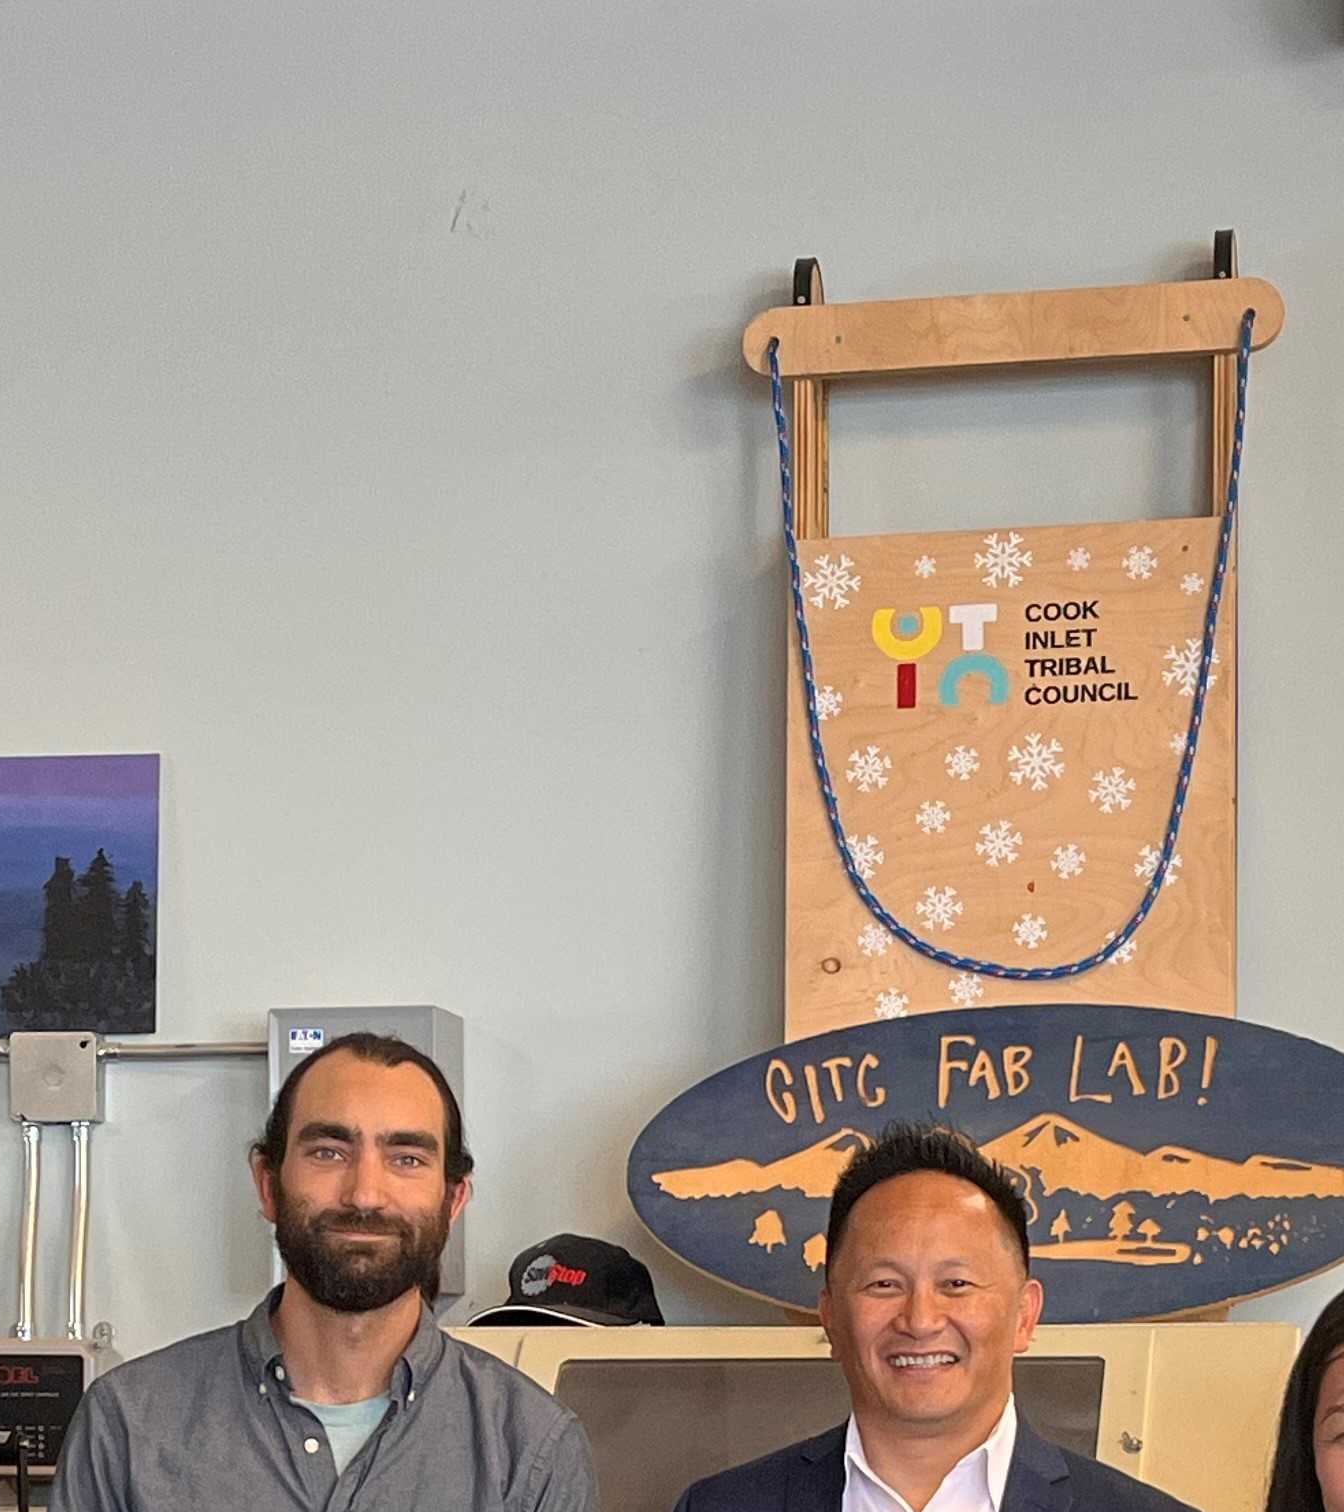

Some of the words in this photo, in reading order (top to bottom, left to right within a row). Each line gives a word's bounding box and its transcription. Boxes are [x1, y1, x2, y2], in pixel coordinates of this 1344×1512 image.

[1024, 600, 1099, 624] COOK
[1024, 628, 1097, 650] INLET
[1024, 655, 1116, 678] TRIBAL
[1024, 682, 1138, 706] COUNCIL
[937, 1034, 1034, 1109] FAB
[1069, 1034, 1219, 1106] LAB!
